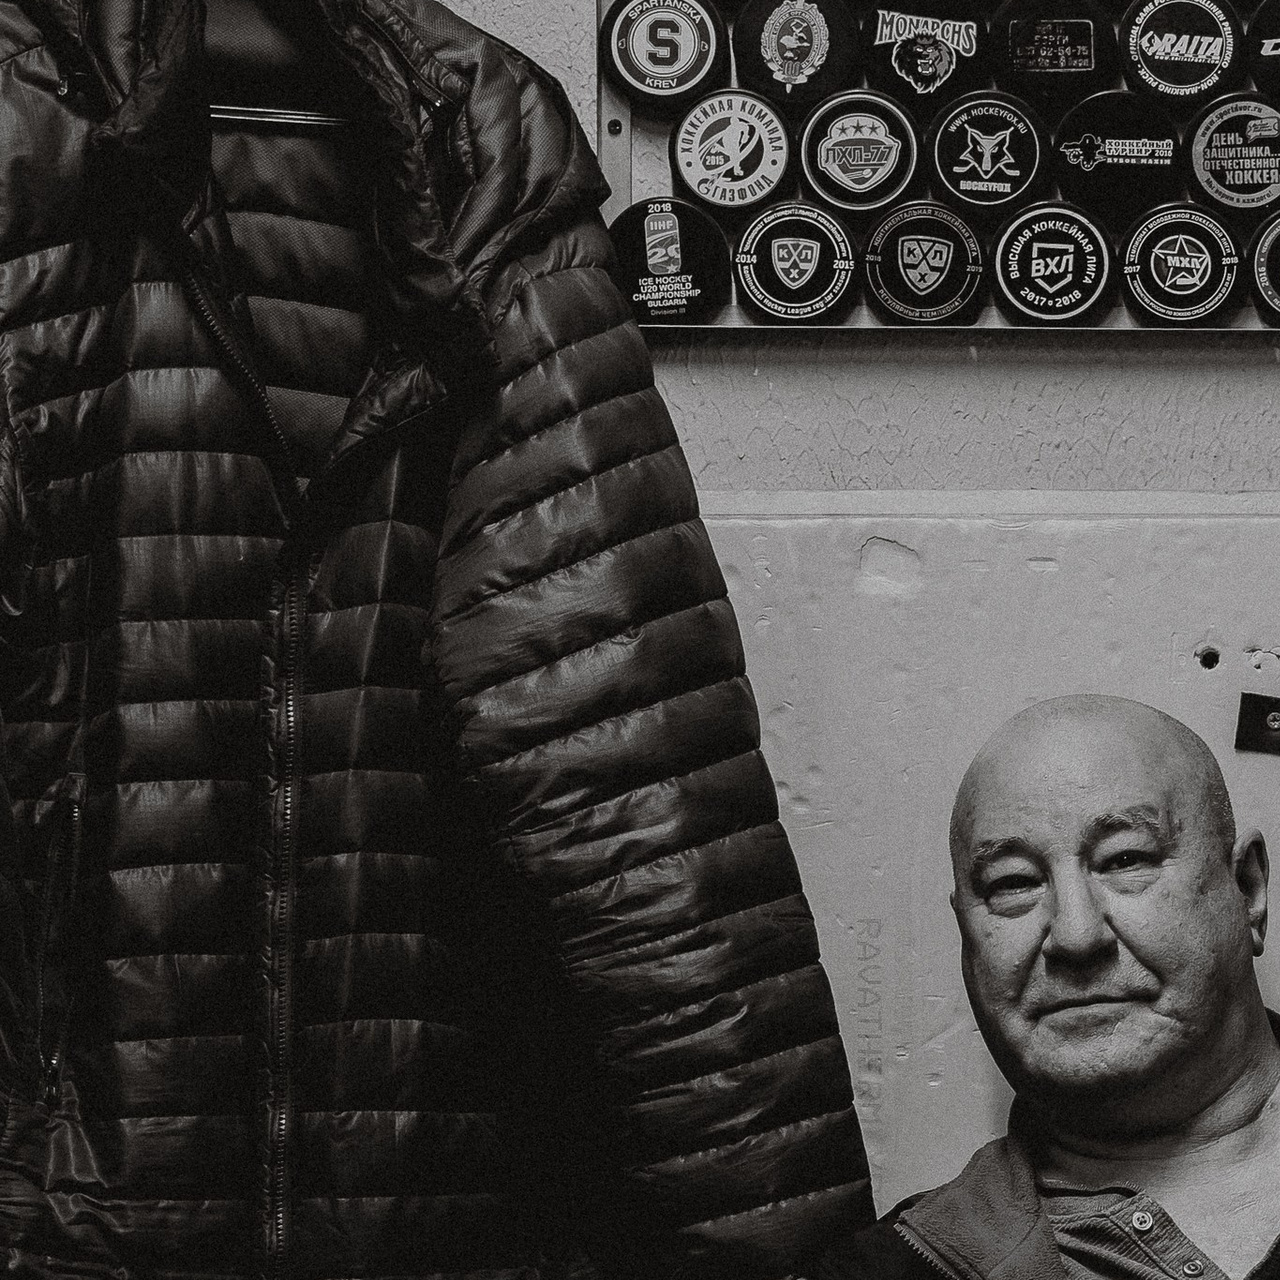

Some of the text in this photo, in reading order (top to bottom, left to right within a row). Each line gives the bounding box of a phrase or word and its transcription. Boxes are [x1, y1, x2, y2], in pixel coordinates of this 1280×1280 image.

[874, 10, 977, 56] MONARCHS
[1155, 33, 1224, 60] RAITA
[645, 77, 678, 88] KREV
[680, 98, 784, 154] ХОККЕЙНАЯ КОМАНДА
[1106, 139, 1173, 149] ХОККЕЙНЫЙ
[1211, 133, 1243, 148] ДЕНЬ
[825, 145, 894, 165] ЛХЛ-77
[1106, 148, 1151, 156] ТУРНИР
[705, 155, 725, 165] 2015
[1225, 169, 1280, 185] ХОККЕЯ
[960, 181, 1011, 193] HOCKEYFOX
[647, 203, 672, 213] 2018
[650, 220, 673, 230] IIHF
[735, 254, 757, 264] 2014
[1009, 221, 1097, 286] ВЫСШАЯ ХОККЕЙНАЯ ЛИГА
[833, 259, 855, 270] 2015
[1032, 254, 1073, 278] ВХЛ
[1166, 254, 1201, 269] МХЛ
[1222, 257, 1239, 265] 2018
[1123, 265, 1141, 274] 2017
[638, 274, 693, 286] ICE HOCKEY
[658, 282, 692, 292] WORLD
[633, 289, 701, 301] CHAMPIONSHIP
[647, 298, 687, 307] BULGARIA
